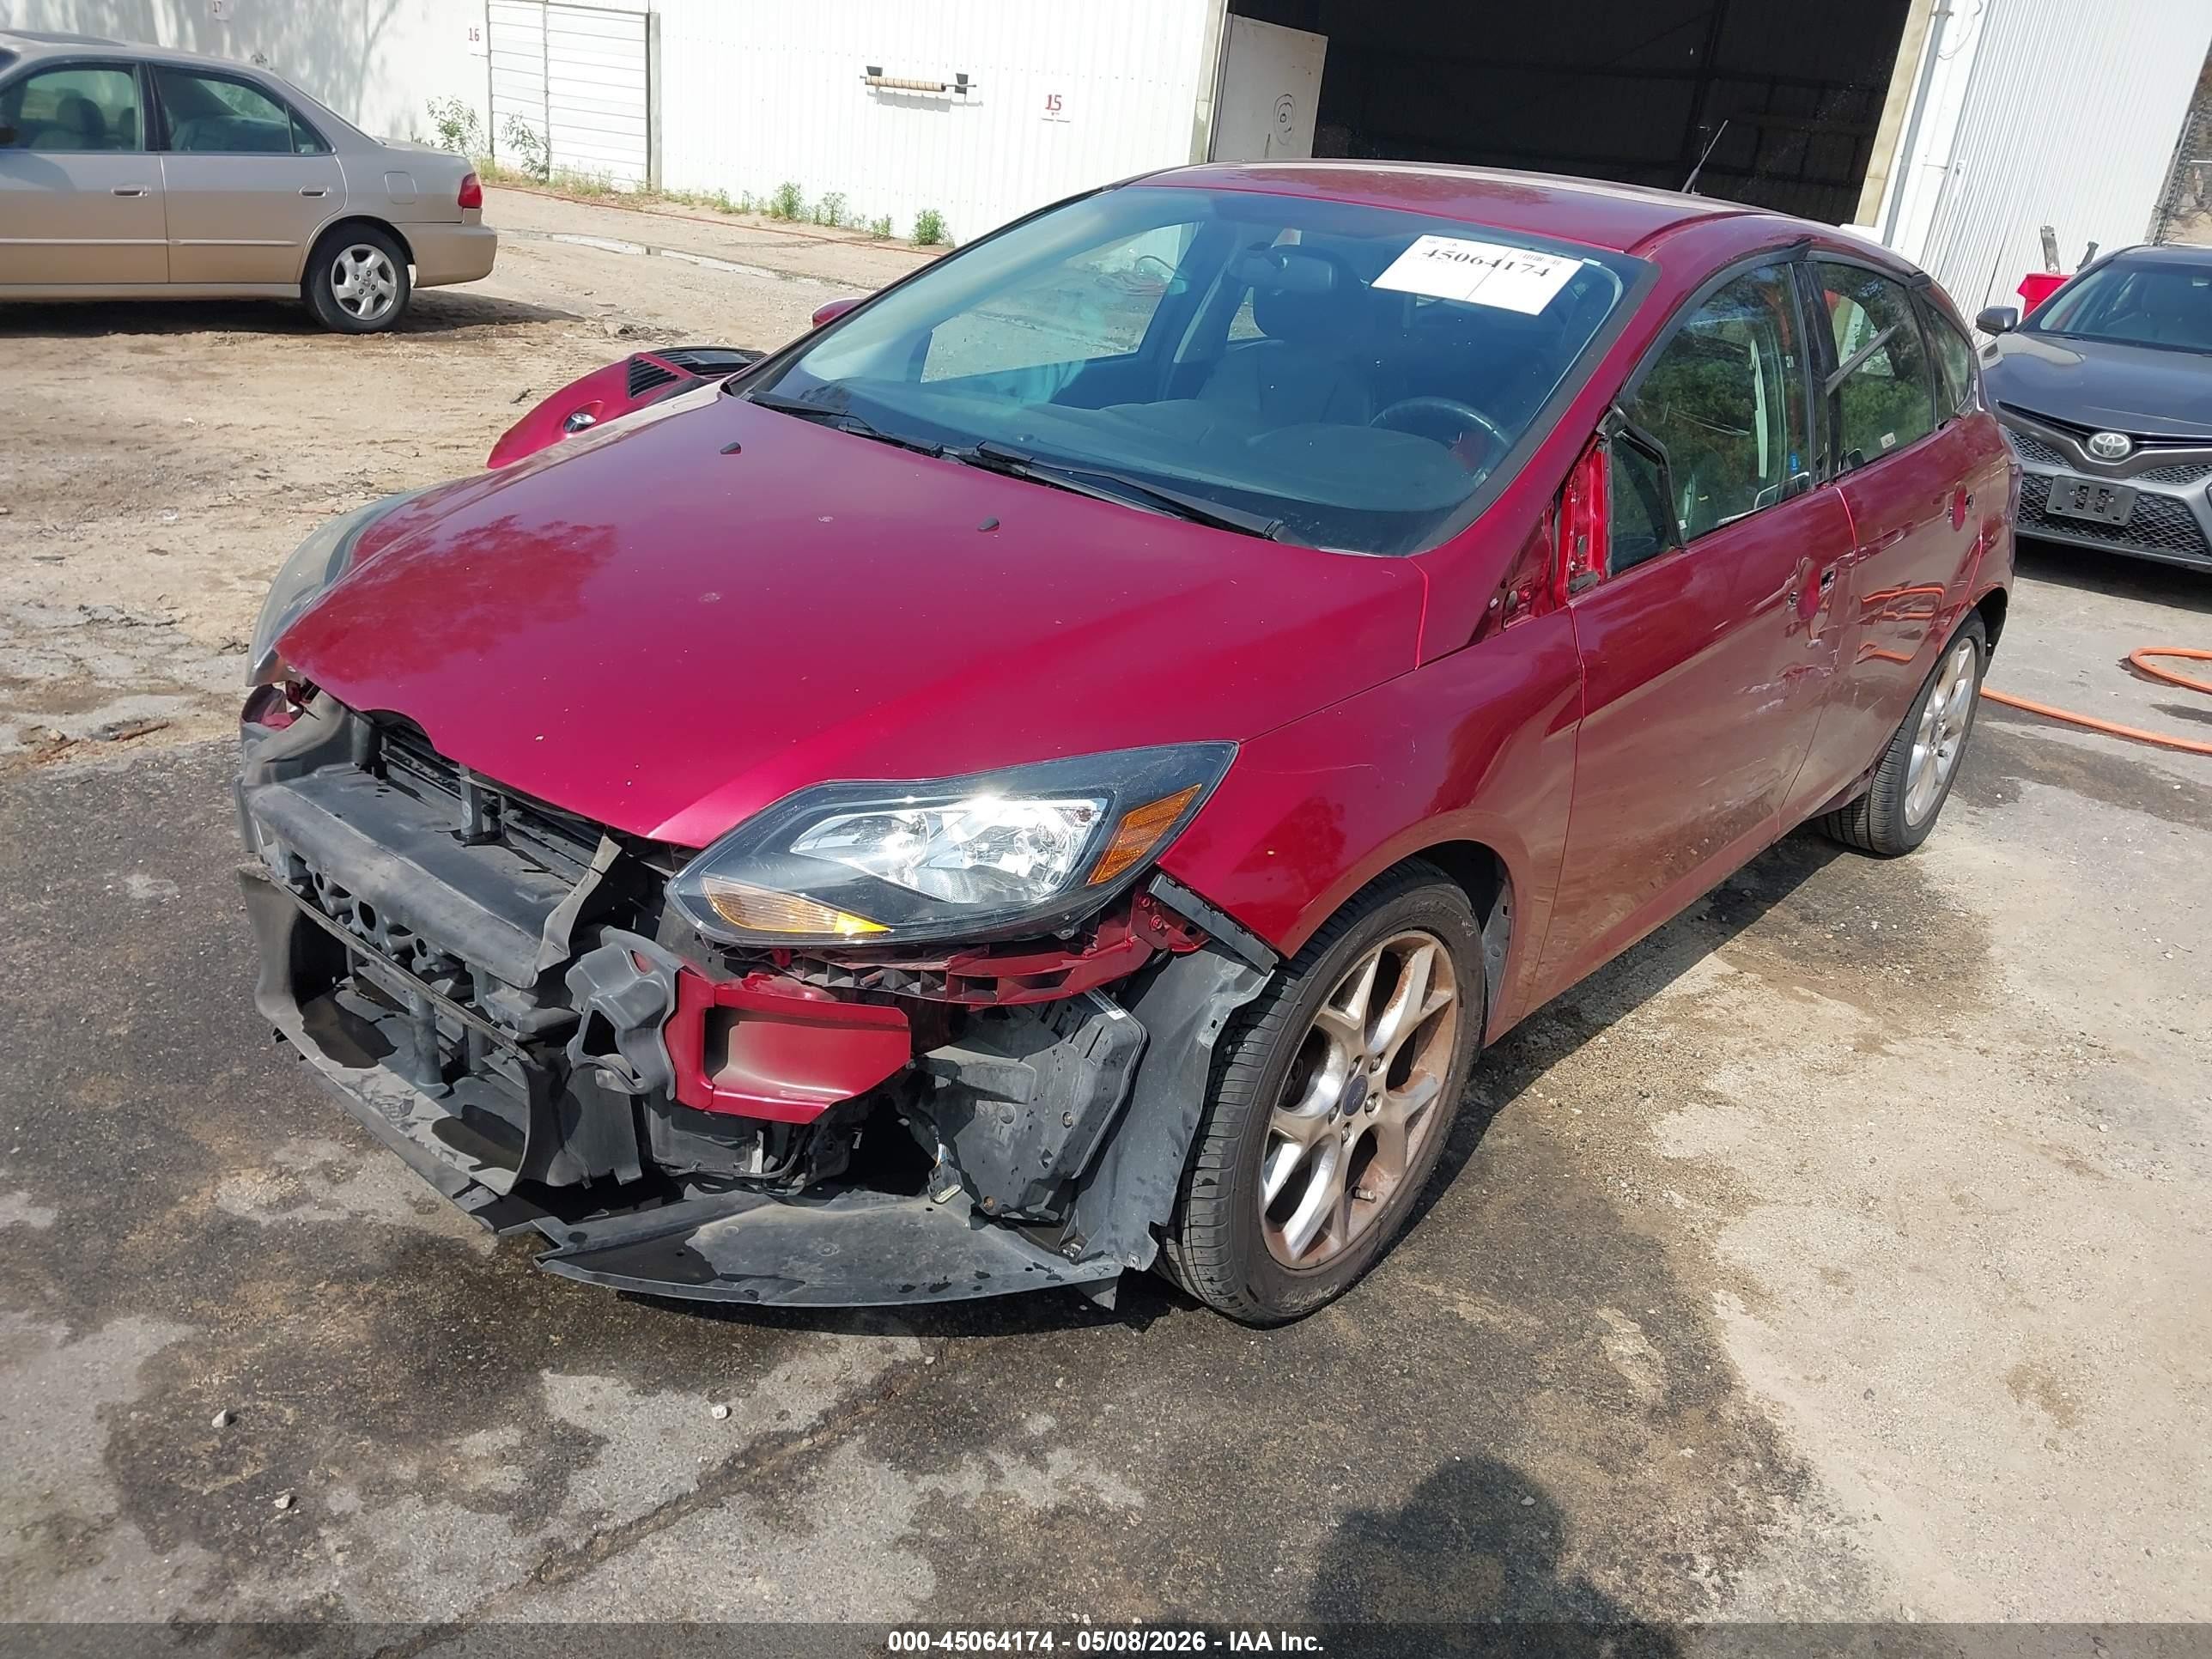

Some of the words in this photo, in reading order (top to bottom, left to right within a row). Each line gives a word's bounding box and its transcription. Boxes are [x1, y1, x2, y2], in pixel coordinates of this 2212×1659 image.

[468, 27, 480, 41] 16
[1045, 94, 1062, 111] 15
[1423, 249, 1551, 276] 45064174
